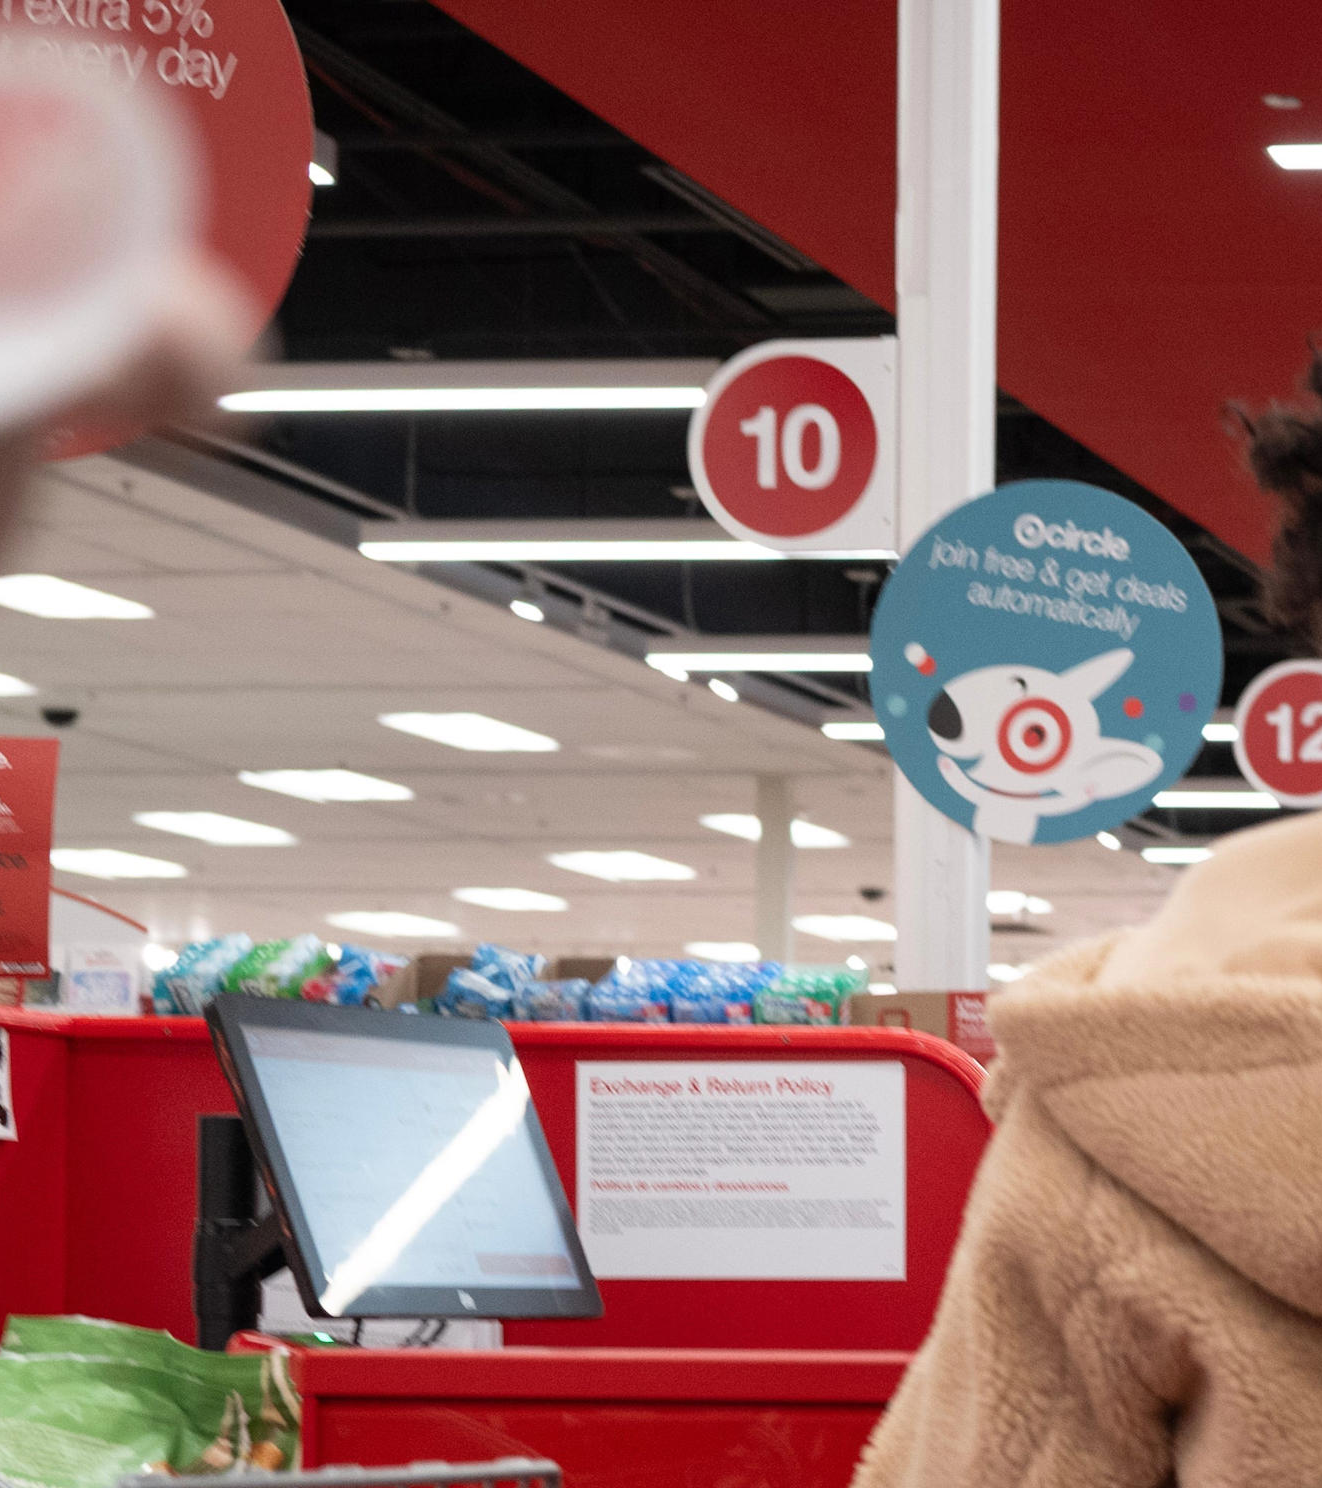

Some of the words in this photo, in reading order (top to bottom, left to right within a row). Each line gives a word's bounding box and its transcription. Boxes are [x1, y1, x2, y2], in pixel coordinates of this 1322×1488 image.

[141, 0, 215, 39] 5%
[156, 36, 239, 99] day
[738, 402, 842, 492] 10
[928, 535, 980, 570] join
[984, 545, 1036, 582] free
[1039, 556, 1061, 588] &
[1065, 567, 1112, 602] get
[1115, 573, 1189, 614] deals
[966, 580, 1142, 642] automatically
[589, 1077, 682, 1098] Exchange
[688, 1077, 702, 1095] &
[706, 1077, 772, 1096] Return
[776, 1077, 834, 1099] Policy
